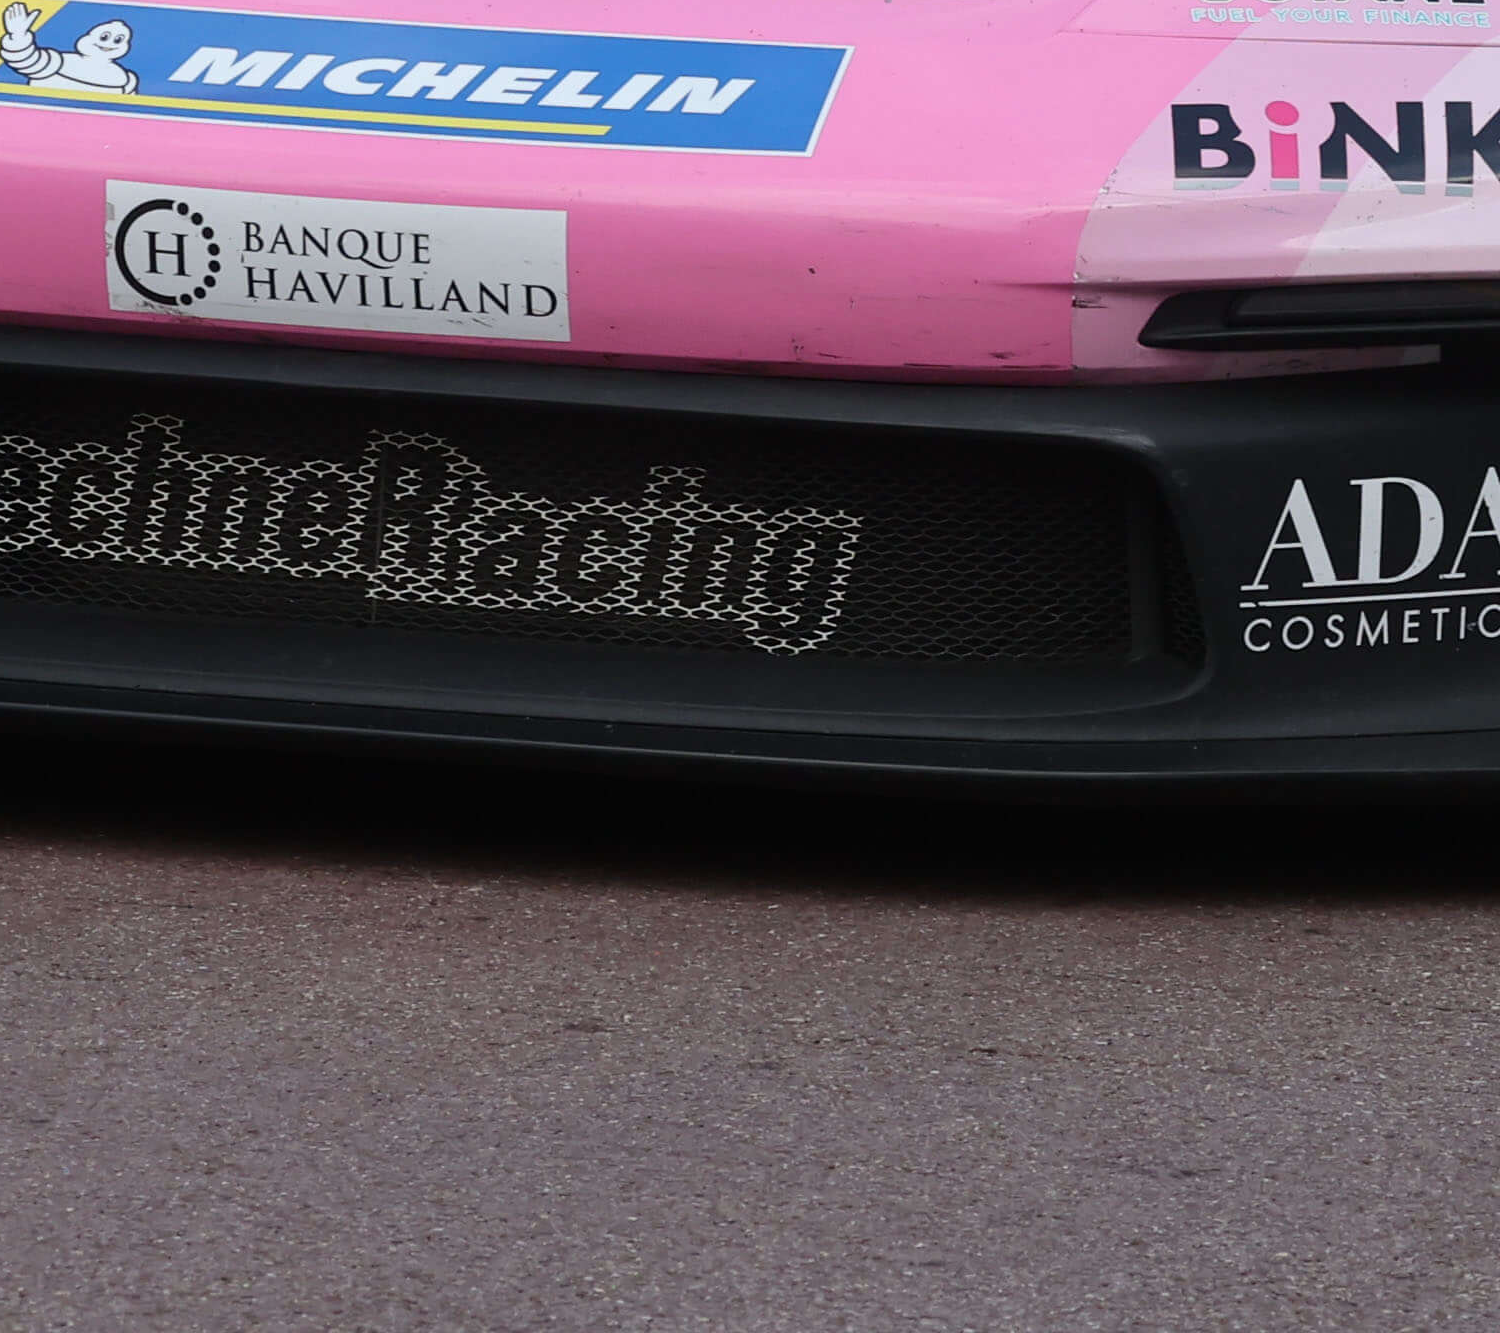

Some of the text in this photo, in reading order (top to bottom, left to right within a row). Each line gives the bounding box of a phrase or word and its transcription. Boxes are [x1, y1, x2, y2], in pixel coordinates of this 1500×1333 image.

[1188, 6, 1492, 28] FUEL YOUR FINANCE
[168, 44, 756, 116] MICHELIN
[147, 220, 432, 278] H BANQUE
[243, 265, 558, 320] HAVILLAND
